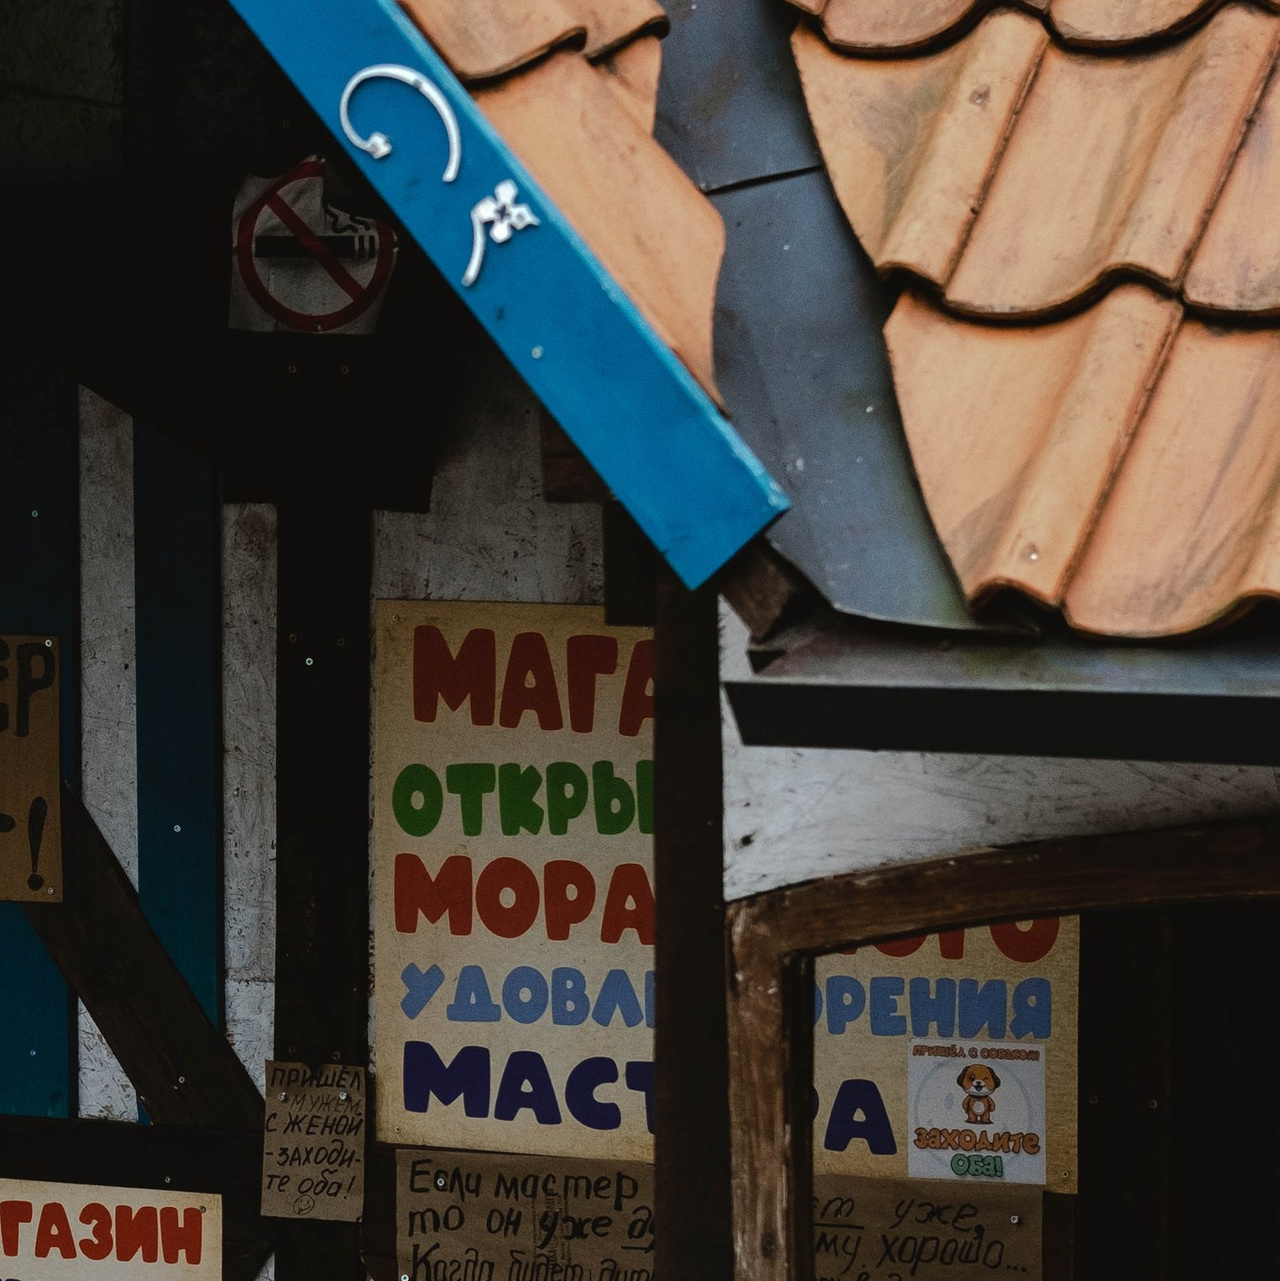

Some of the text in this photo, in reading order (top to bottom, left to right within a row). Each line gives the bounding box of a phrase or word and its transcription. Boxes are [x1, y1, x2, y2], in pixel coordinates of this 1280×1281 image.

[400, 961, 1052, 1039] УДОВЛ РЕНИЯ
[912, 1043, 967, 1058] ПРИШЁЛ
[270, 1066, 361, 1091] ПРИШЁЛ
[409, 1158, 482, 1202] Если
[494, 1171, 638, 1211] мастер
[408, 1205, 465, 1237] то
[486, 1207, 523, 1237] он
[537, 1209, 613, 1249] уже
